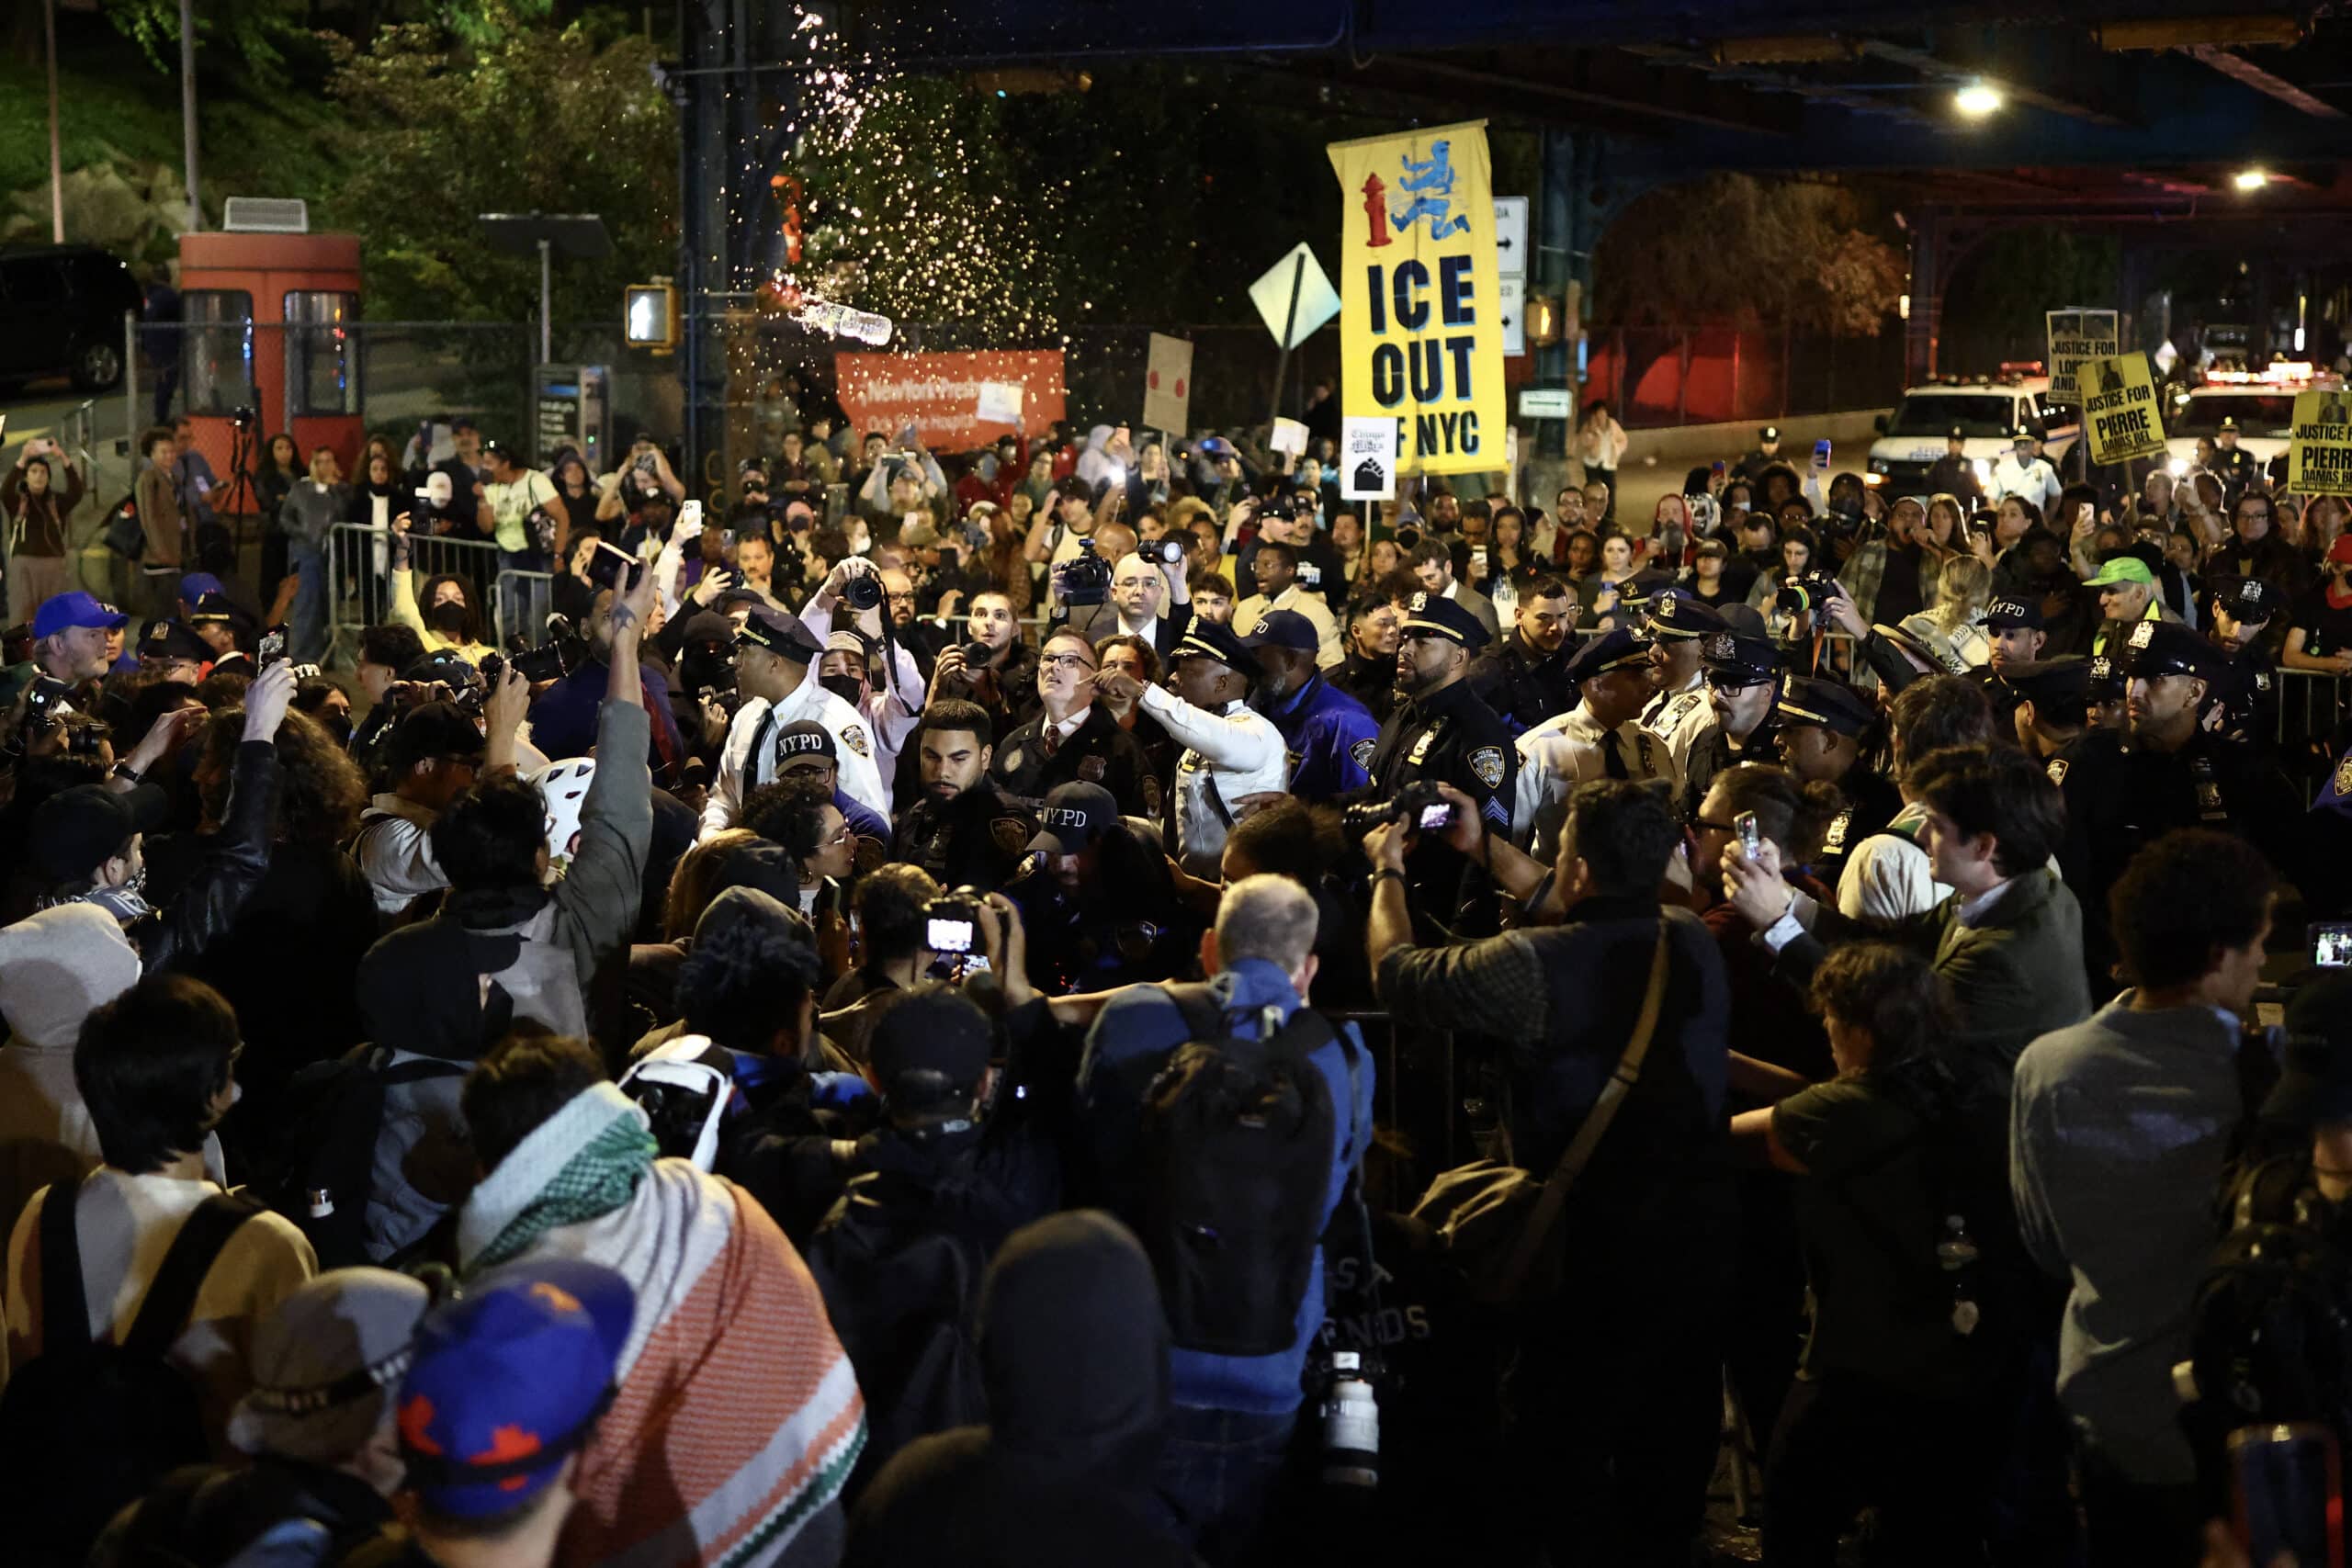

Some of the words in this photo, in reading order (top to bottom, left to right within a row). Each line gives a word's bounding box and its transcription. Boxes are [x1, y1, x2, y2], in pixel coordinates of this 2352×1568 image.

[1367, 254, 1476, 335] ICE
[2052, 341, 2091, 355] JUSTICE
[2095, 341, 2116, 355] FOR
[1372, 335, 1476, 409] OUT
[2052, 376, 2075, 390] AND
[2086, 389, 2125, 412] JUSTICE
[2126, 384, 2151, 404] FOR
[1416, 411, 1479, 458] NYC
[2096, 408, 2151, 440] PIERRE
[2296, 423, 2344, 441] JUSTICE
[2301, 446, 2352, 468] PIERR
[294, 663, 321, 678] YPD
[778, 733, 822, 756] NYPD
[1043, 807, 1087, 828] NYPD
